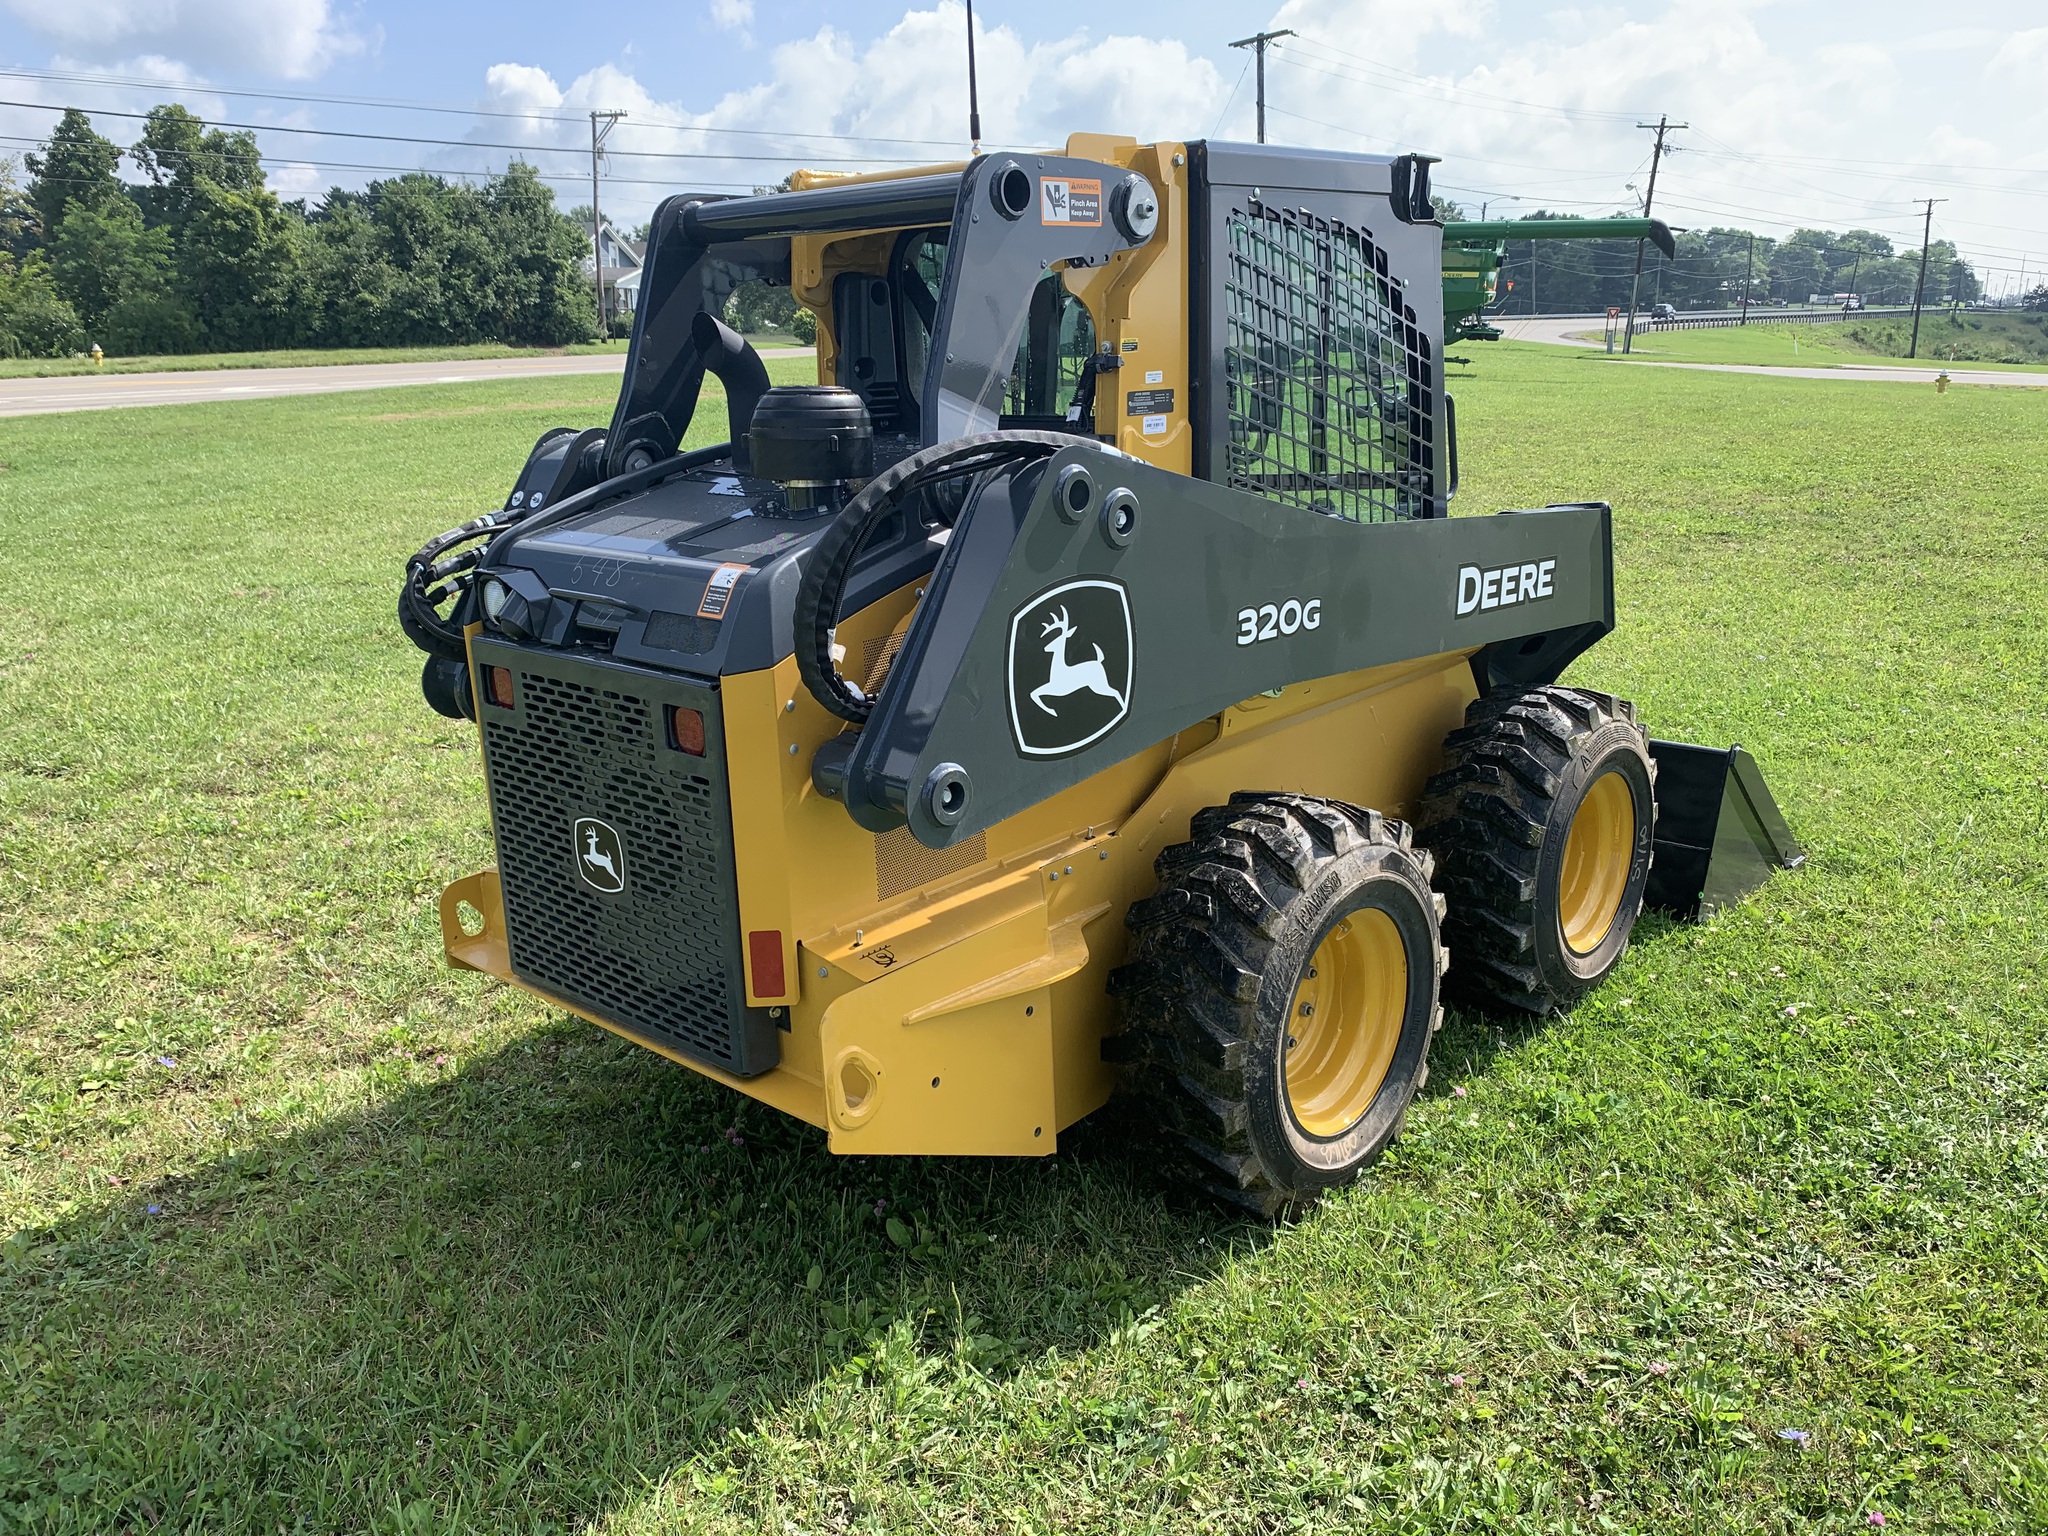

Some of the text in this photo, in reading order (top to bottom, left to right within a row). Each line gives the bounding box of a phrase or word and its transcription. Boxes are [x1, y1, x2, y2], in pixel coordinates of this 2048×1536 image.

[1075, 183, 1098, 191] WARNING
[1070, 199, 1098, 208] Pinch Area
[1070, 209, 1095, 217] Keep Away
[571, 556, 631, 587] 548
[1456, 559, 1556, 616] DEERE
[1236, 599, 1321, 646] 320G
